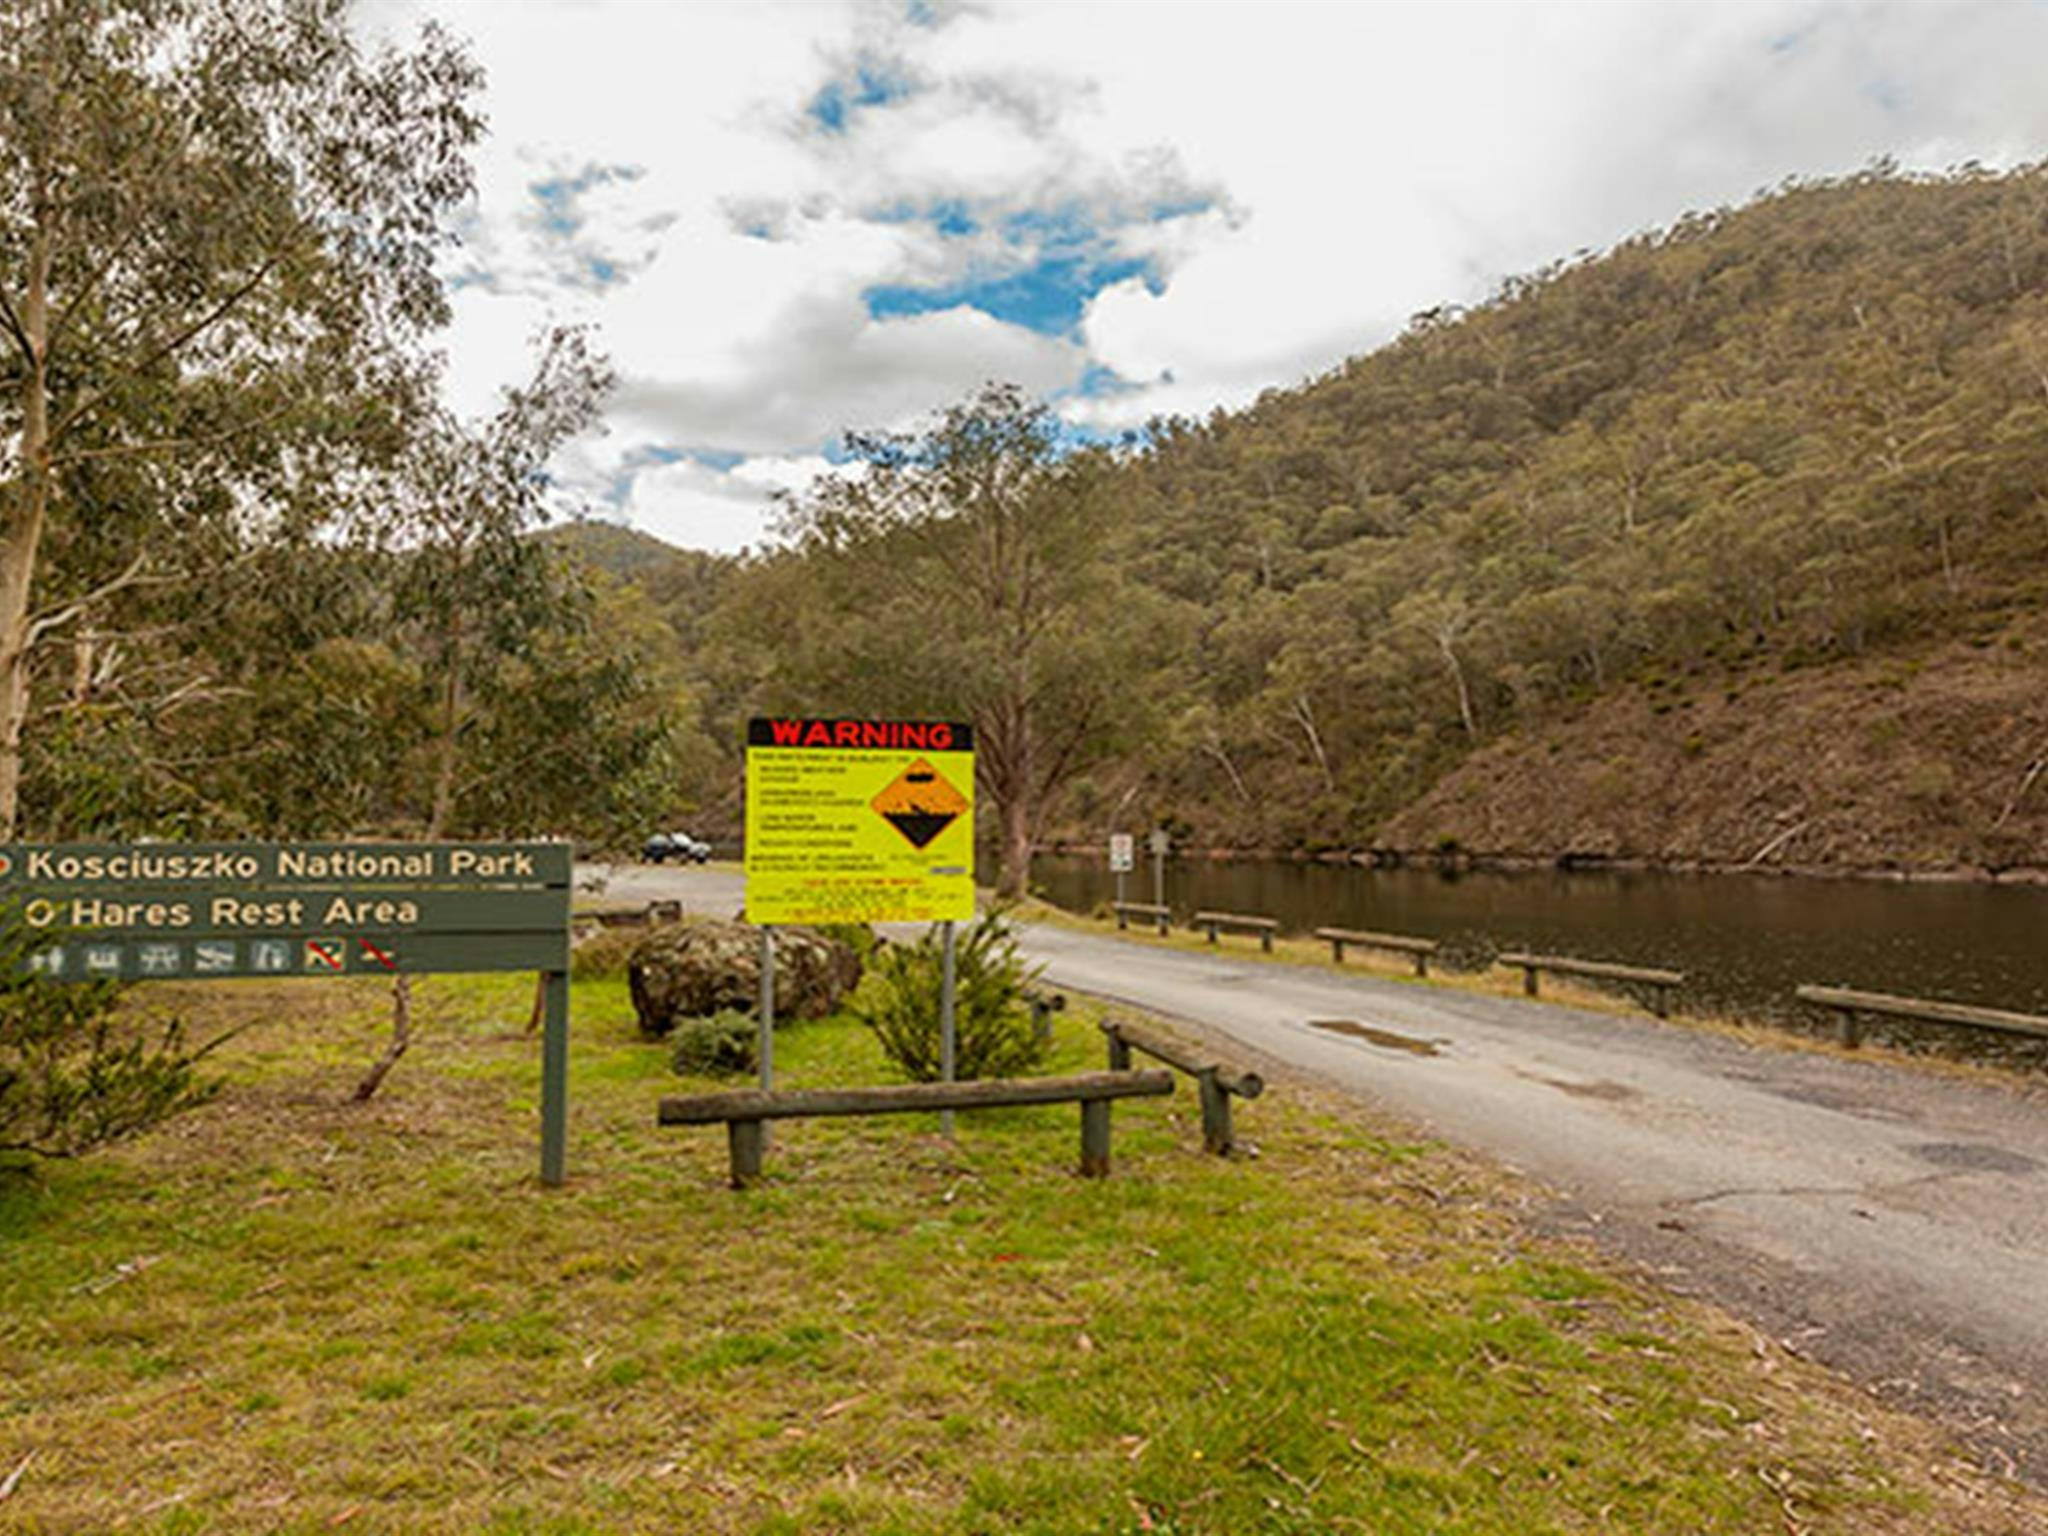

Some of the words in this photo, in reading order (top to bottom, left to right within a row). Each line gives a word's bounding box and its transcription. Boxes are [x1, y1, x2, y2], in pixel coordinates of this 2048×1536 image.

[771, 720, 953, 749] WARNING
[27, 851, 258, 879] Kosciuszko
[278, 850, 433, 877] National
[451, 850, 533, 876] Park
[72, 899, 191, 926] Hares
[211, 898, 302, 925] Rest
[323, 898, 418, 924] Area
